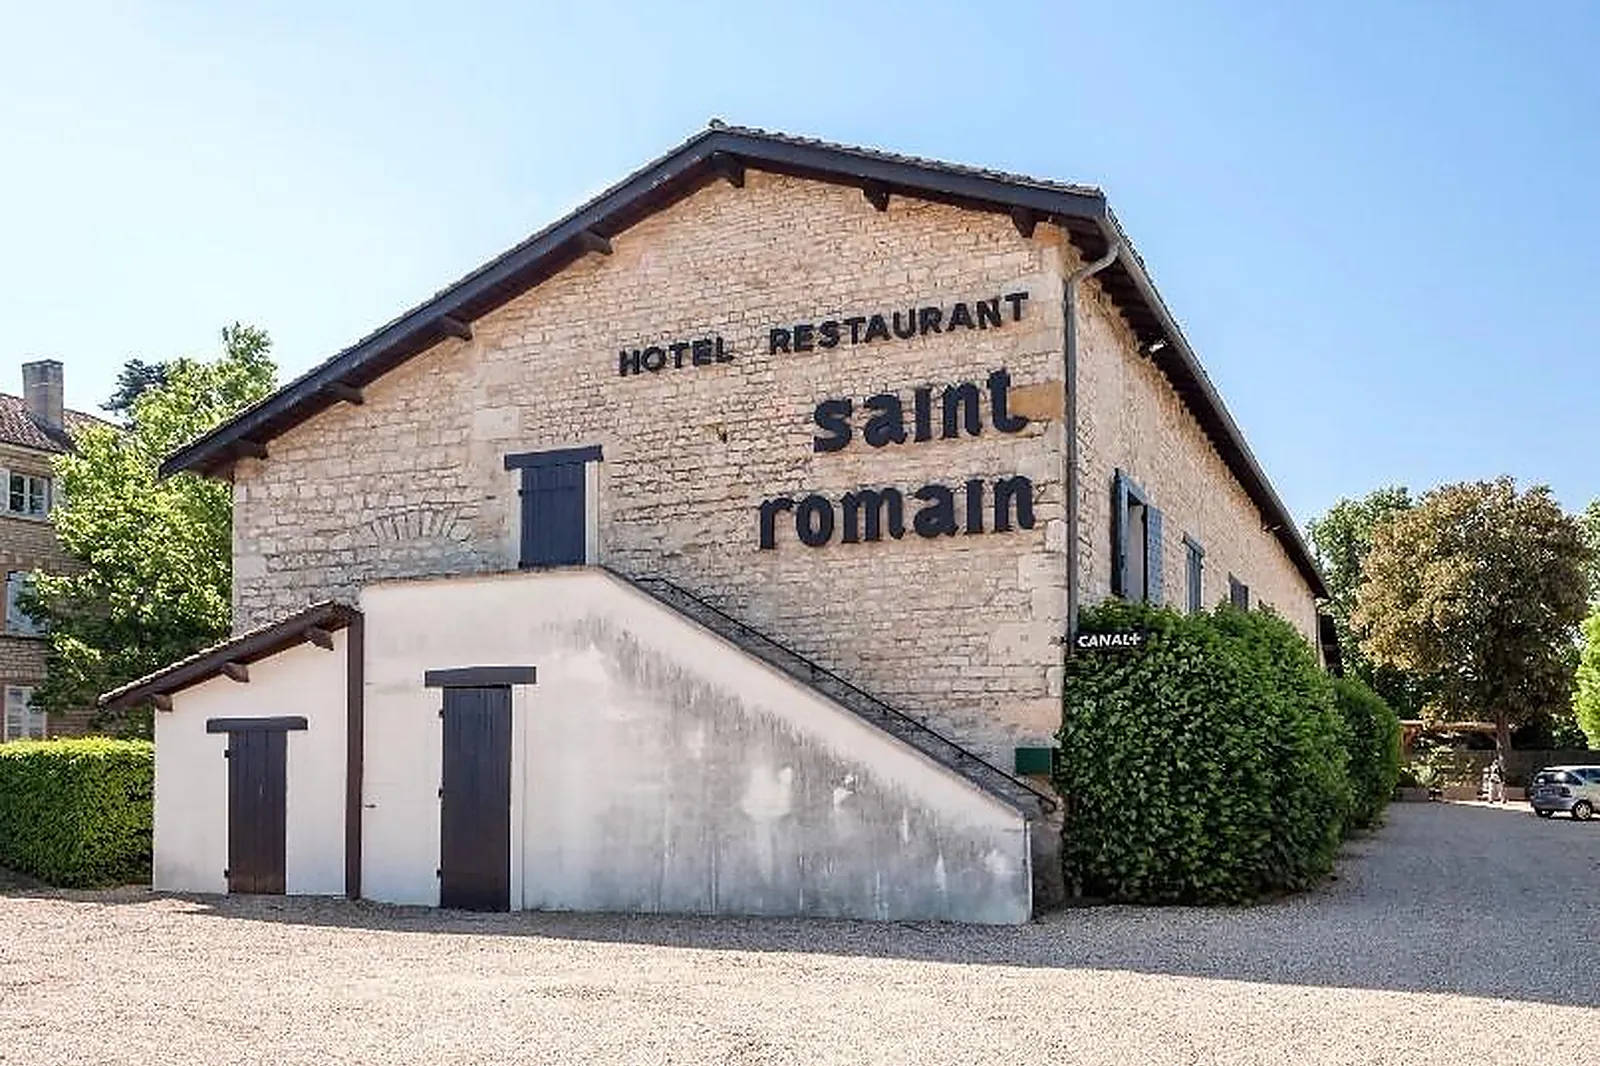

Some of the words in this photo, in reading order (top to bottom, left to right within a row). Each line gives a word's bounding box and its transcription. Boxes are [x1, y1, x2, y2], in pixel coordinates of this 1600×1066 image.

[618, 336, 734, 376] HOTEL
[769, 291, 1029, 355] RESTAURANT
[814, 367, 1029, 453] saint
[759, 475, 1036, 550] romain
[1077, 633, 1141, 648] CANAL+
